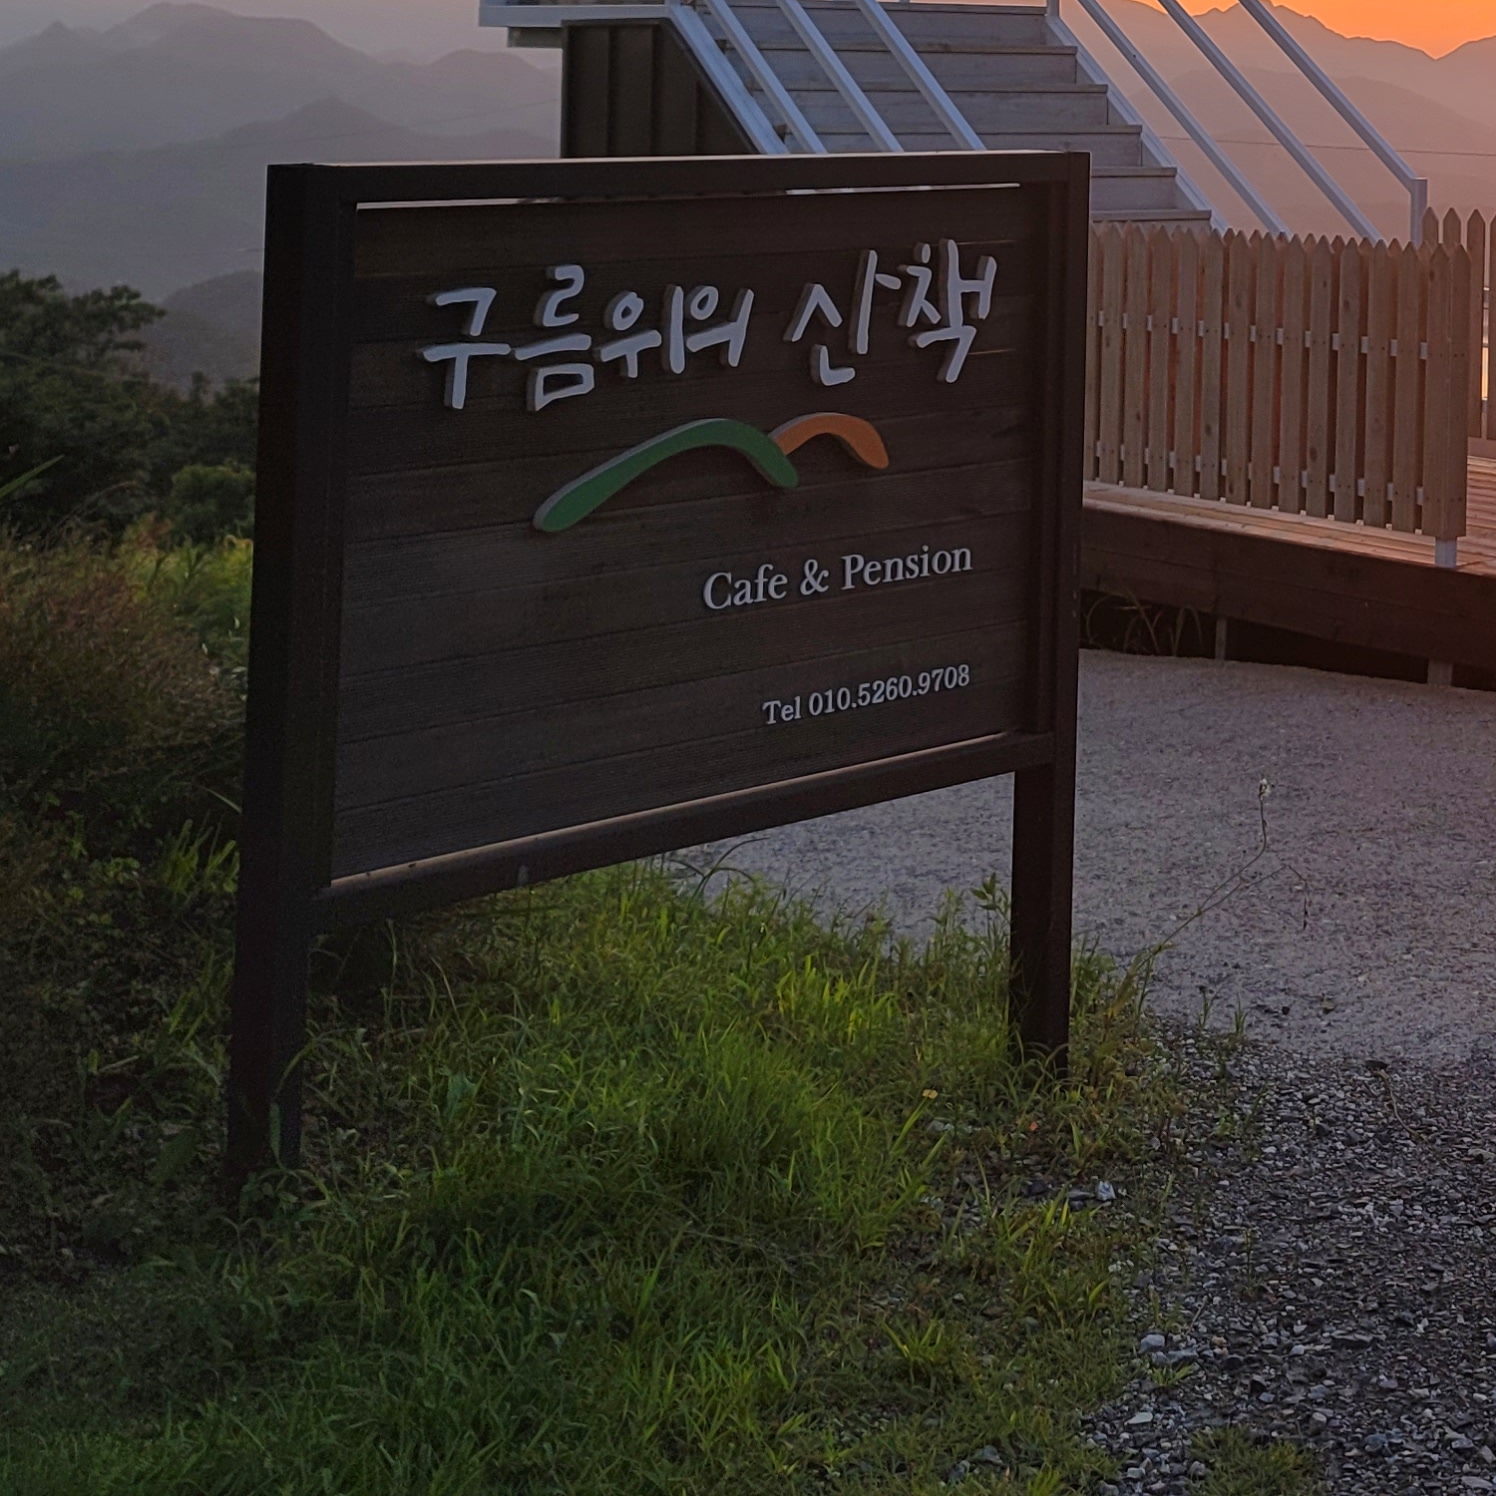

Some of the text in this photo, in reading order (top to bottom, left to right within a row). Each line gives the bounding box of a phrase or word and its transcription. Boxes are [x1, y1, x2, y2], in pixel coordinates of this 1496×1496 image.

[420, 238, 997, 411] 구름위의 산책
[702, 544, 973, 610] Cafe & Pension
[763, 664, 971, 725] Tel 010.5260.9708
